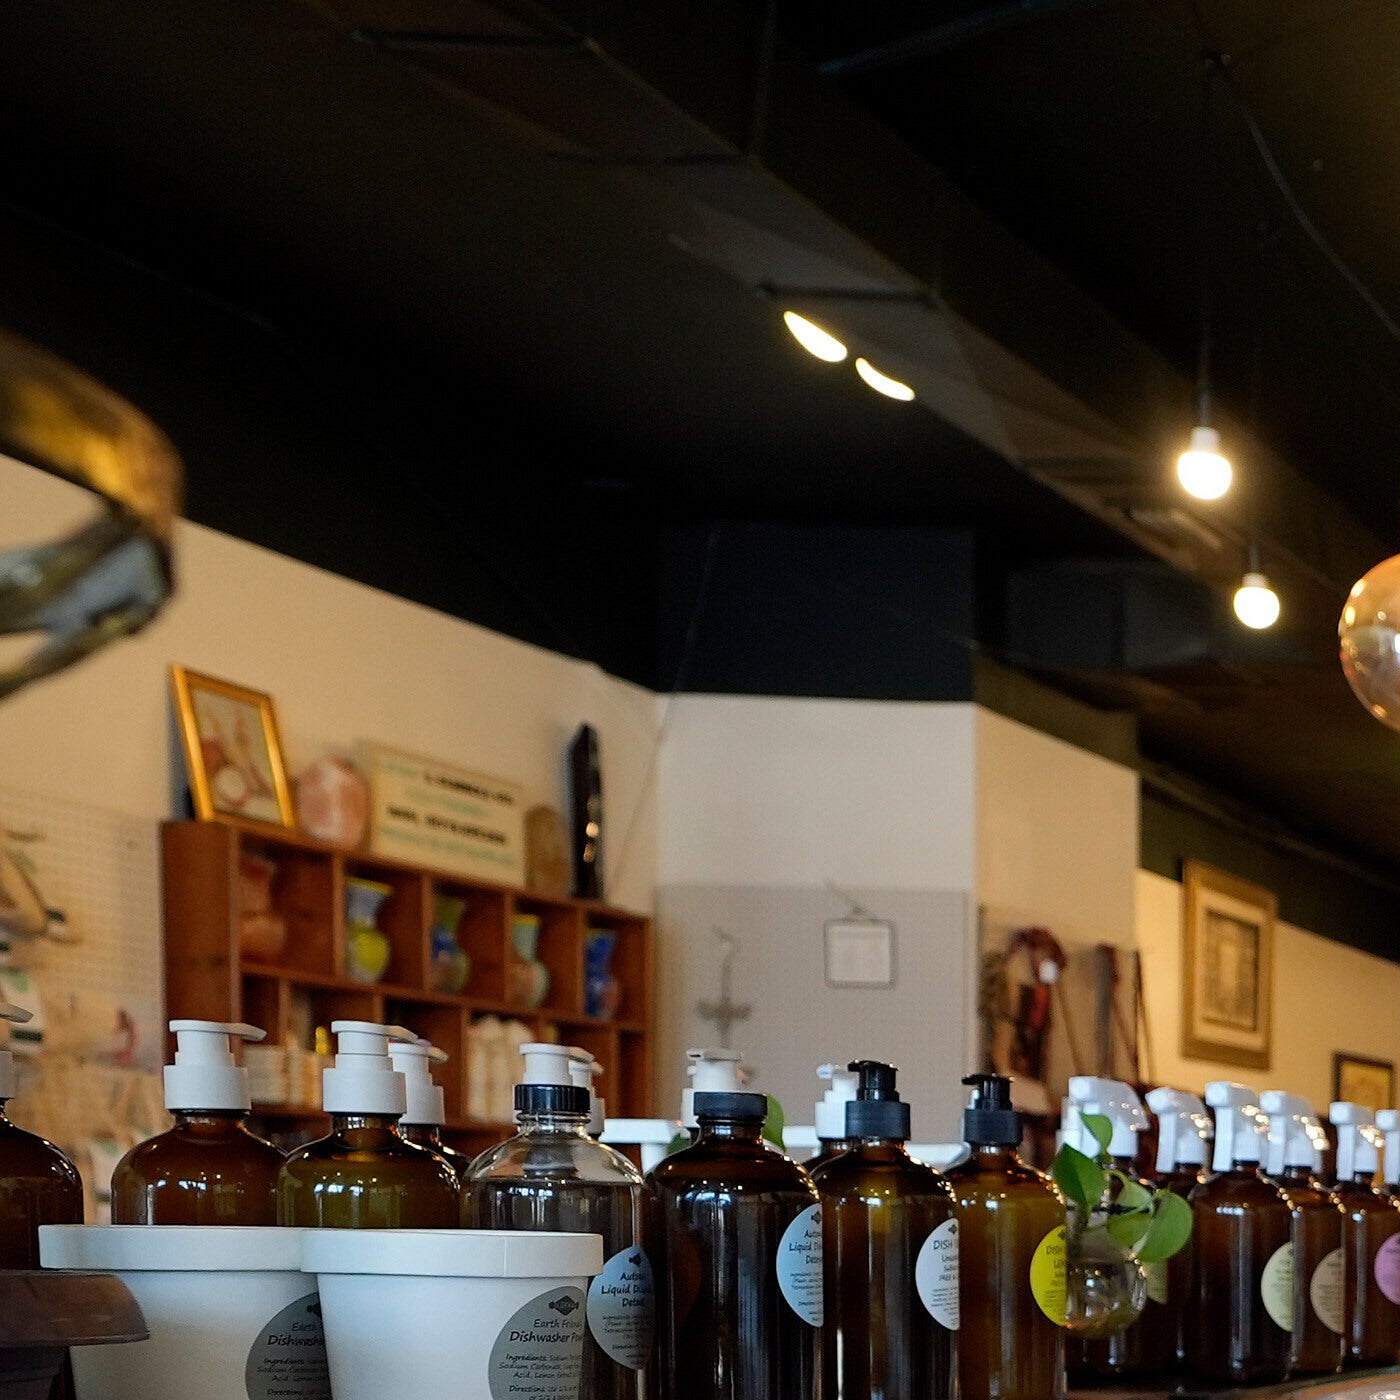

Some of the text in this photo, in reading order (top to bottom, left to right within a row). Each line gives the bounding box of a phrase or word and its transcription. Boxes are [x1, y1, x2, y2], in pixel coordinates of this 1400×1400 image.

[933, 1239, 953, 1250] DISH
[601, 1285, 630, 1297] Liquid
[534, 1318, 560, 1329] Earth
[509, 1330, 570, 1343] Dishwasher
